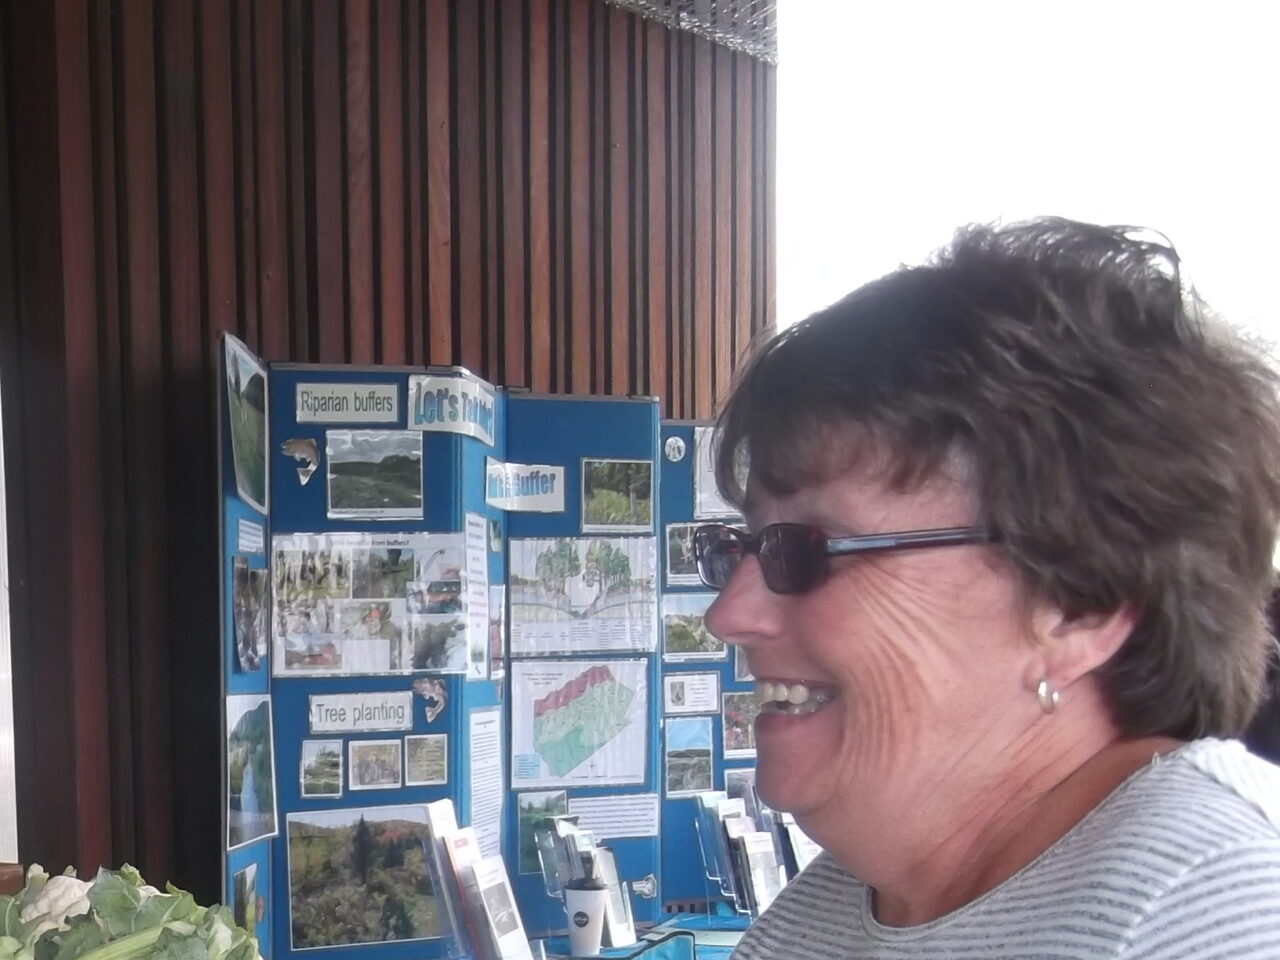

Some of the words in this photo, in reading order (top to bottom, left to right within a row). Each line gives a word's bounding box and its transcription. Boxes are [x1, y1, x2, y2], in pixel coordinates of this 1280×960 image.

[300, 390, 349, 417] Riparian
[354, 390, 393, 412] buffers
[414, 382, 459, 425] Let's
[316, 703, 347, 723] Tree
[353, 702, 405, 726] planting
